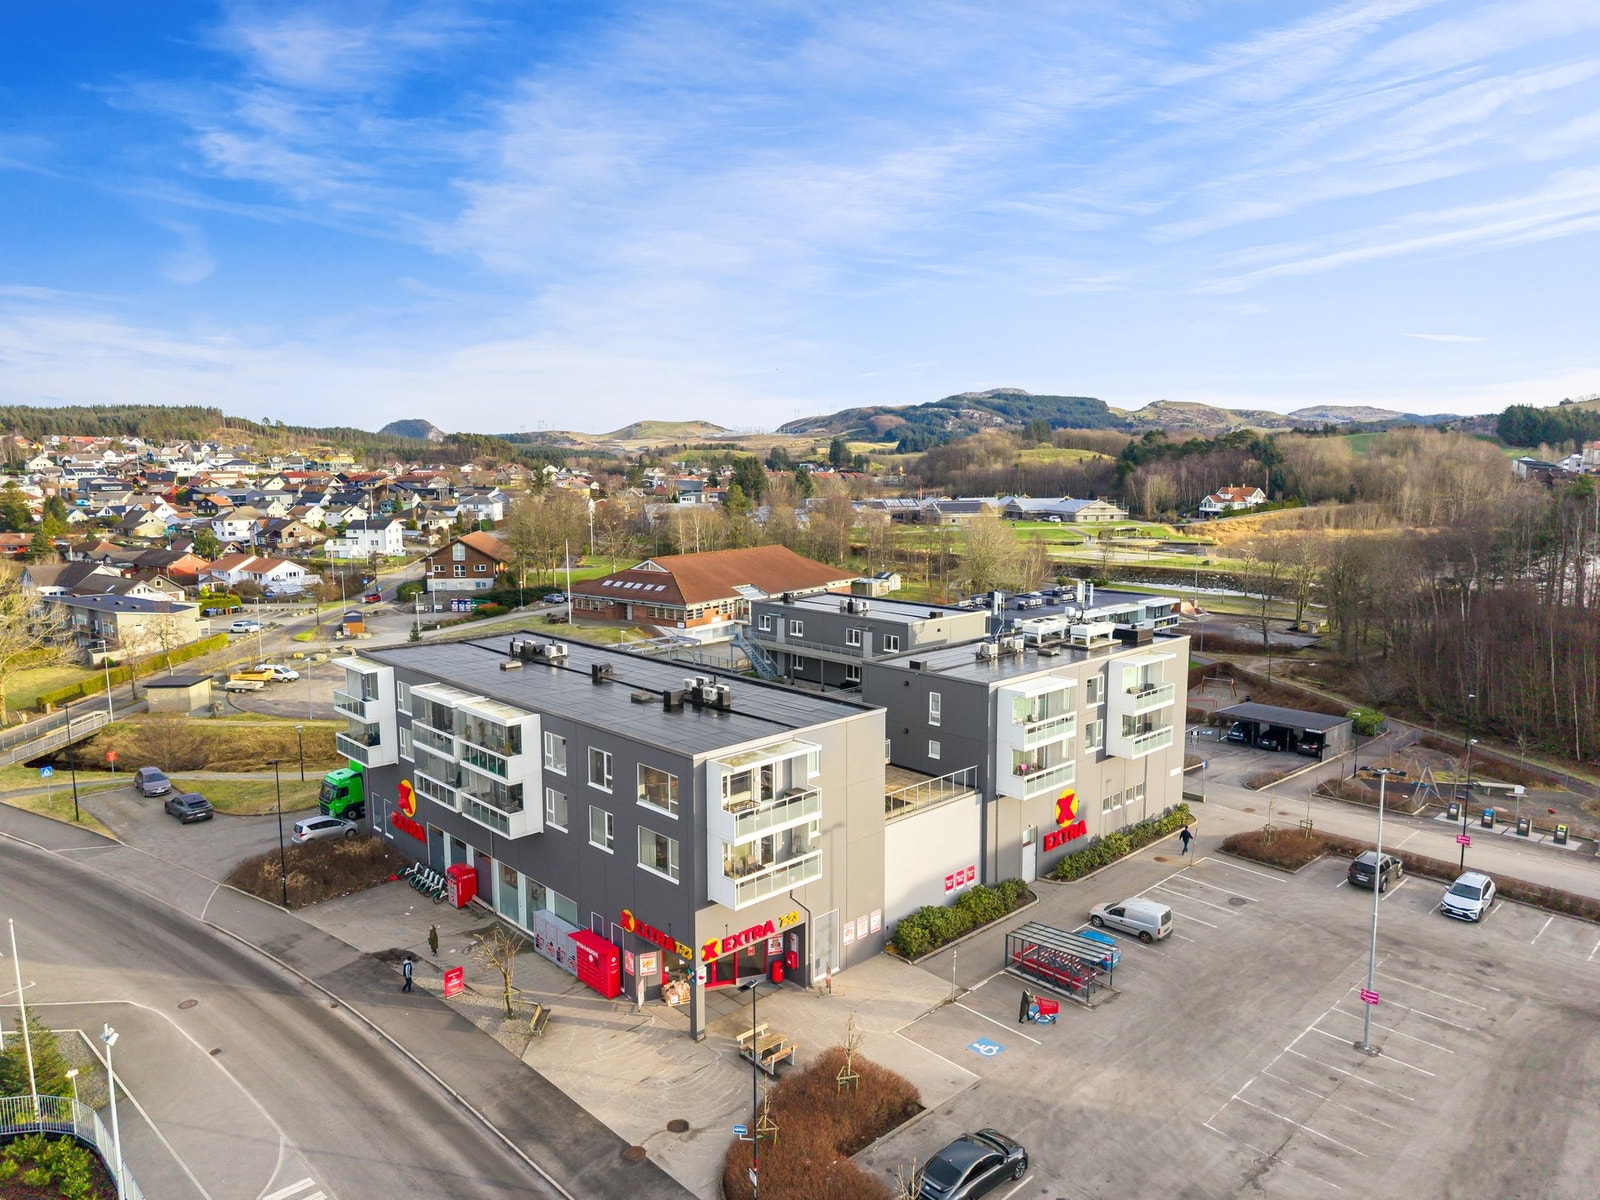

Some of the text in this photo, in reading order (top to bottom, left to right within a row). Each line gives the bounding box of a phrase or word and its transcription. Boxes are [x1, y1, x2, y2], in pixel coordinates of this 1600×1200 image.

[1043, 819, 1088, 852] EXTRA
[634, 918, 677, 955] EXTRA
[722, 919, 776, 954] EXTRA
